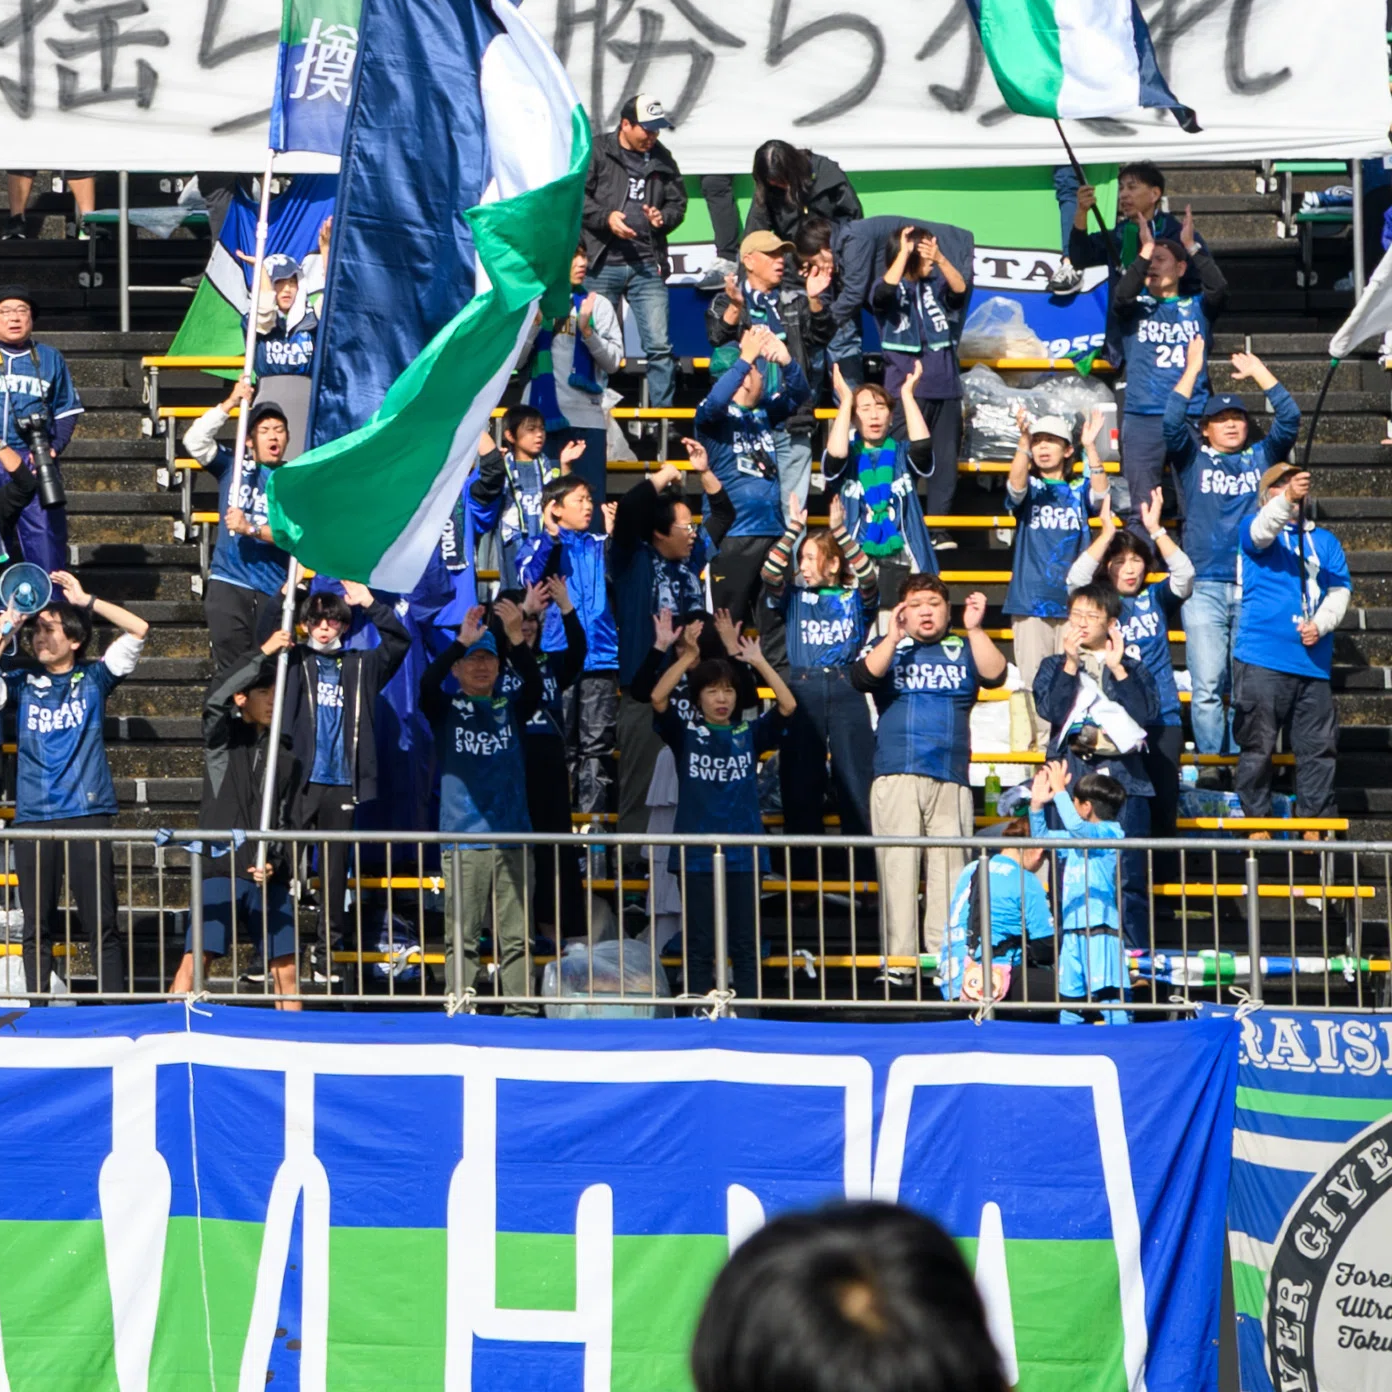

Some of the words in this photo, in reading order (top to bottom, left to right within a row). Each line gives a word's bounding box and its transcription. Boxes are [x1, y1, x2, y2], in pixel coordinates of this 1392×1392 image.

[1137, 319, 1201, 335] POCARI
[1137, 330, 1197, 344] SWEAT
[1155, 344, 1187, 368] 24
[1200, 479, 1259, 496] SWEAT
[1029, 515, 1081, 531] SWEA
[893, 663, 968, 682] POCARI
[893, 673, 965, 690] SWEAT
[28, 699, 88, 721] POCARI
[27, 712, 84, 733] SWEAT
[454, 724, 514, 746] POCARI
[454, 737, 511, 757] SWEAT
[688, 751, 753, 770] POCARI
[688, 762, 748, 783] SWEAT
[1294, 1136, 1392, 1261] GIVE
